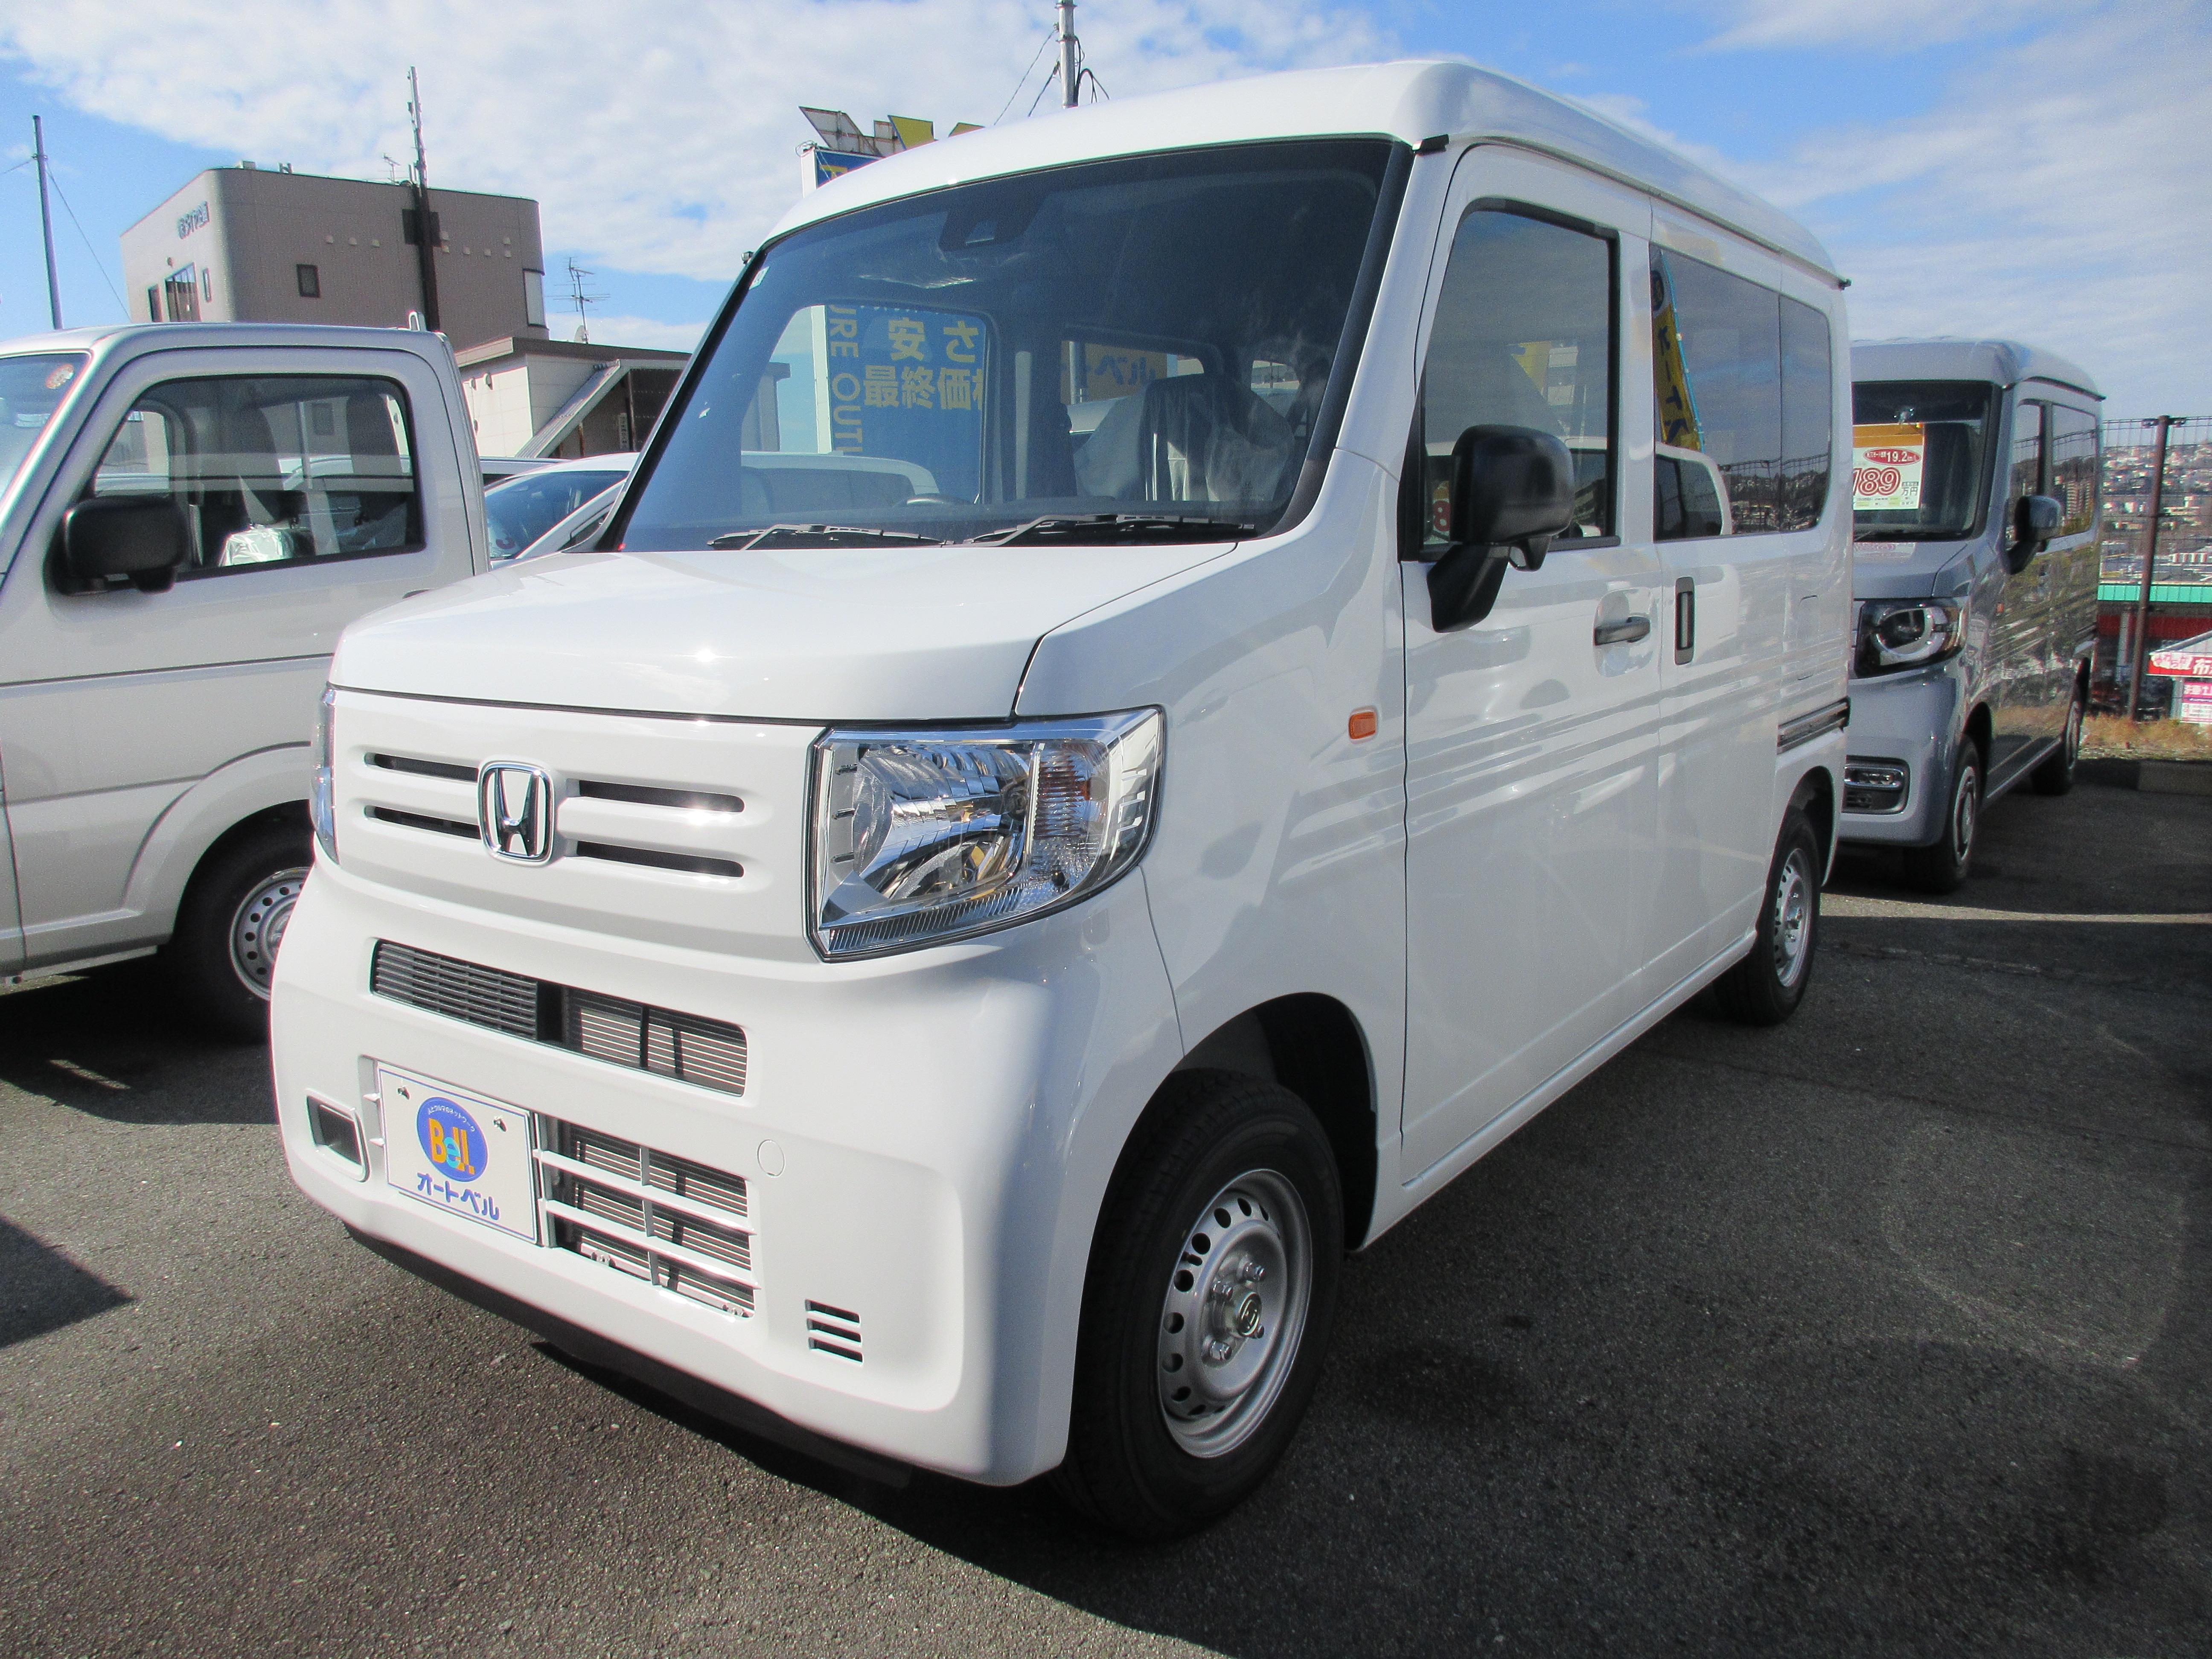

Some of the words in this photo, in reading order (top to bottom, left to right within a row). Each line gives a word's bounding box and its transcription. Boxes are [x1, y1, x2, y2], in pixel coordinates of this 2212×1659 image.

[417, 1172, 500, 1220] オートベル
